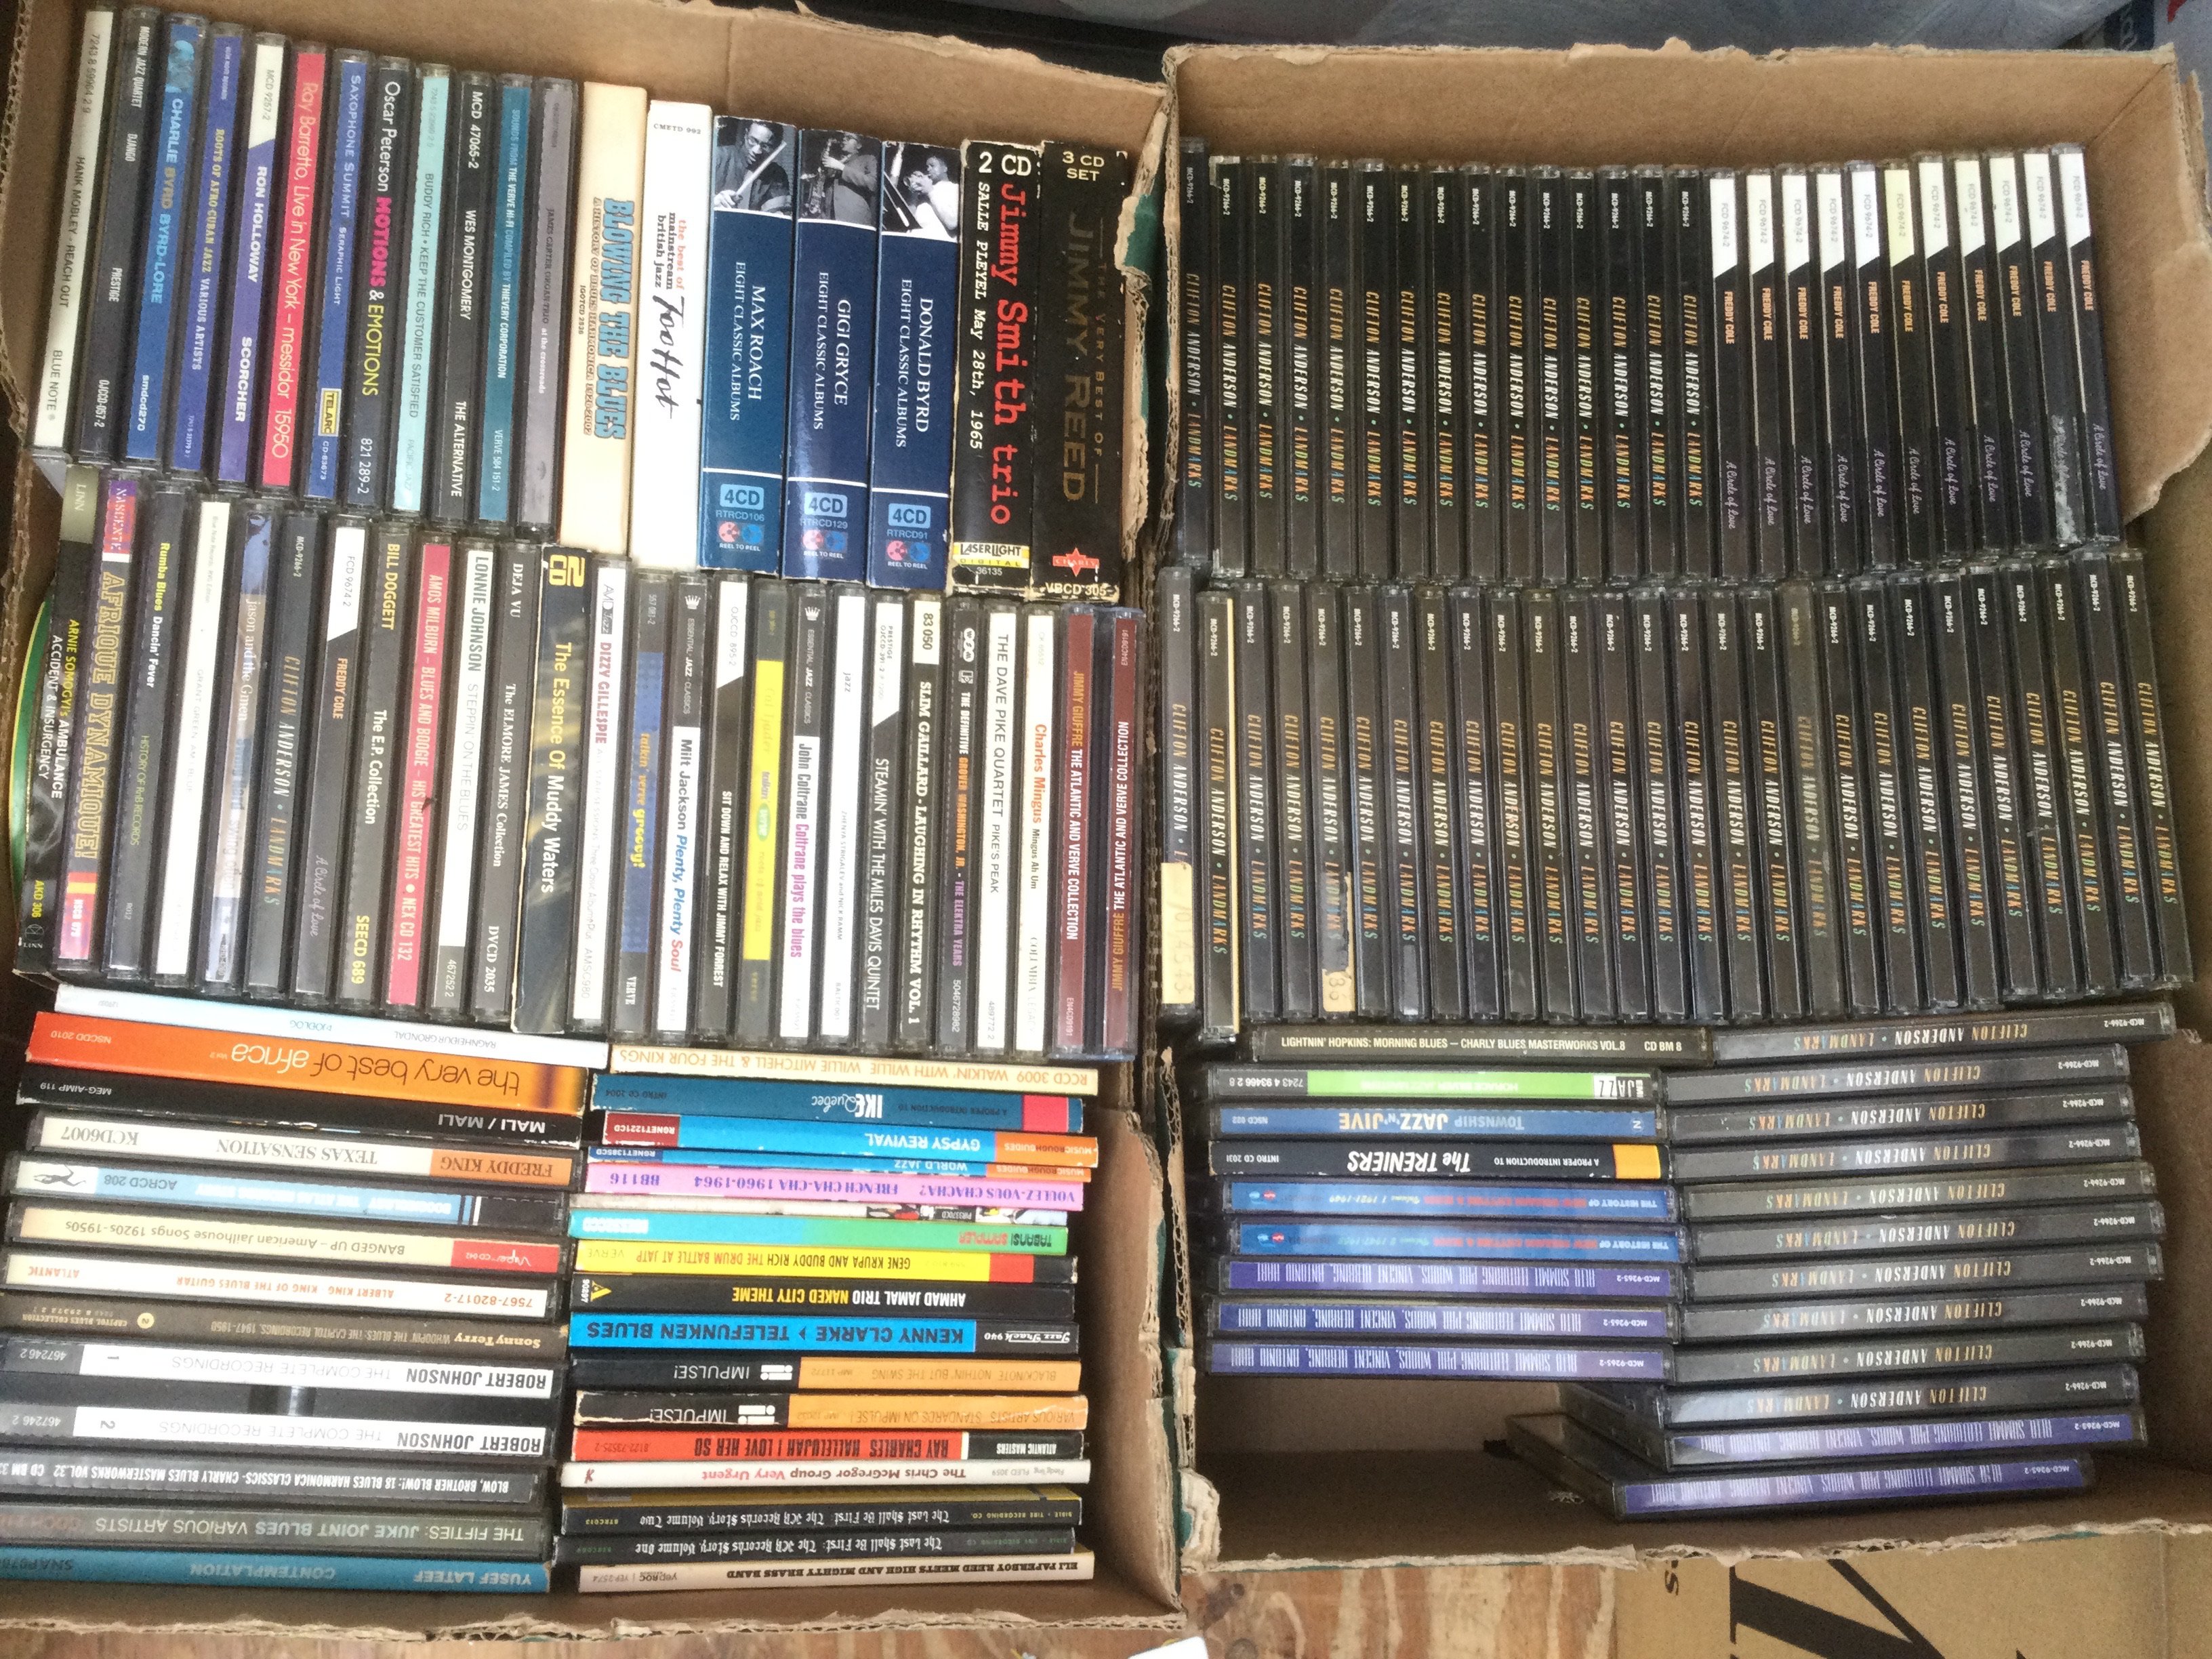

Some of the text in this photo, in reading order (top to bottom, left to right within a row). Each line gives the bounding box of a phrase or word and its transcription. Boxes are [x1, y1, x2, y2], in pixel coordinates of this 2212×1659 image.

[166, 99, 183, 163] CHARLIE
[341, 75, 361, 218] SAXOPHONE SUMMIT
[653, 123, 683, 132] CMETD
[979, 152, 1031, 176] 2 CD
[1063, 151, 1104, 167] 3 CD
[1067, 169, 1100, 181] SET
[150, 213, 171, 304] BYRD-LORE
[363, 81, 401, 396] Oscar Peterson MOTIONS & EMOTIONS
[460, 210, 476, 320] WES MONTGOMERY
[655, 215, 666, 287] british jazz
[665, 212, 676, 289] mainstream
[676, 219, 687, 290] the best of
[235, 167, 267, 422] RON HOLLOWAY SCORCHER
[272, 83, 319, 459] Ray Barretto, Live in New York messidor 15950
[594, 198, 635, 439] BLOWING THE BLUES
[969, 182, 989, 449] SALLE PLEYEL May 28th, 1965
[1223, 285, 1235, 337] CLIFTON
[1725, 291, 1734, 344] FREDDY COLE
[730, 262, 746, 421] EIGHT CLASSIC ALBUMS
[748, 286, 766, 400] MAX ROACH
[834, 299, 851, 405] GIGI GRYCE
[916, 299, 933, 432] DONALD BYRD
[991, 184, 1027, 524] Jimmy Smith trio
[47, 350, 62, 411] BLUE NOTE
[1223, 342, 1236, 408] ANDERSON
[324, 392, 335, 434] TELARC
[357, 438, 372, 494] 821 289-2
[1223, 426, 1237, 501] LANDMARKS
[1725, 470, 1736, 497] Circle
[716, 510, 764, 521] RTRCD106
[724, 488, 760, 506] 4CD
[1725, 510, 1736, 529] Love
[382, 544, 401, 630] BILL DOGGETT
[977, 567, 1002, 575] 36135
[146, 543, 171, 688] Rumba Blues Dancin' Fever
[468, 557, 489, 672] LONNIE JOHNSON
[75, 572, 125, 859] AFRIQUE DYNAMIQUE!
[332, 658, 348, 720] FREDDY COLE
[991, 634, 1008, 817] THE DAVE PIKE QUARTET
[541, 642, 571, 893] The Essence Of Muddy Waters
[1030, 723, 1046, 889] Charles Mingus Mingus Ah Um
[1912, 707, 1946, 928] CLIFTON ANDERSON LANDMARKS
[670, 739, 692, 972] Milt Jackson Plenty, Plenty Soul
[352, 916, 369, 984] SEECD 689
[50, 1030, 75, 1039] 2010
[1282, 1037, 1448, 1048] LIGHTNIN' HOPKINS: MORNING BLUES
[1644, 1041, 1682, 1052] CD BM 8
[1794, 1023, 2028, 1051] CLIFTON ANDERSON LANDMARKS
[230, 1043, 520, 1096] the very best of africa
[870, 1063, 1087, 1085] RCCD 3009 WALKIN' WITH WILLIE
[61, 1126, 138, 1145] KCD6007
[438, 1113, 483, 1128] MALI
[501, 1119, 545, 1133] MALI
[614, 1125, 674, 1134] RGNET1221CD
[864, 1132, 980, 1150] GYPSY REVIVAL
[441, 1156, 552, 1177] FREDDY KING
[1347, 1151, 1438, 1172] TRENIERS
[1442, 1151, 1471, 1172] The
[1506, 1158, 1559, 1166] INTRODUCTION
[444, 1293, 533, 1307] 7567-82017-2
[733, 1288, 966, 1307] AHMAD JAMAL TRIO NAKED CITY THEME
[587, 1322, 963, 1343] KENNY CLARKE TELEFUNKEN BLUES
[406, 1369, 546, 1389] ROBERT JOHNSON
[674, 1366, 749, 1378] IMPULSE!
[96, 1518, 247, 1534] VARIOUS ARTISTS
[962, 1562, 1078, 1572] ELI PAPERBOY REED
